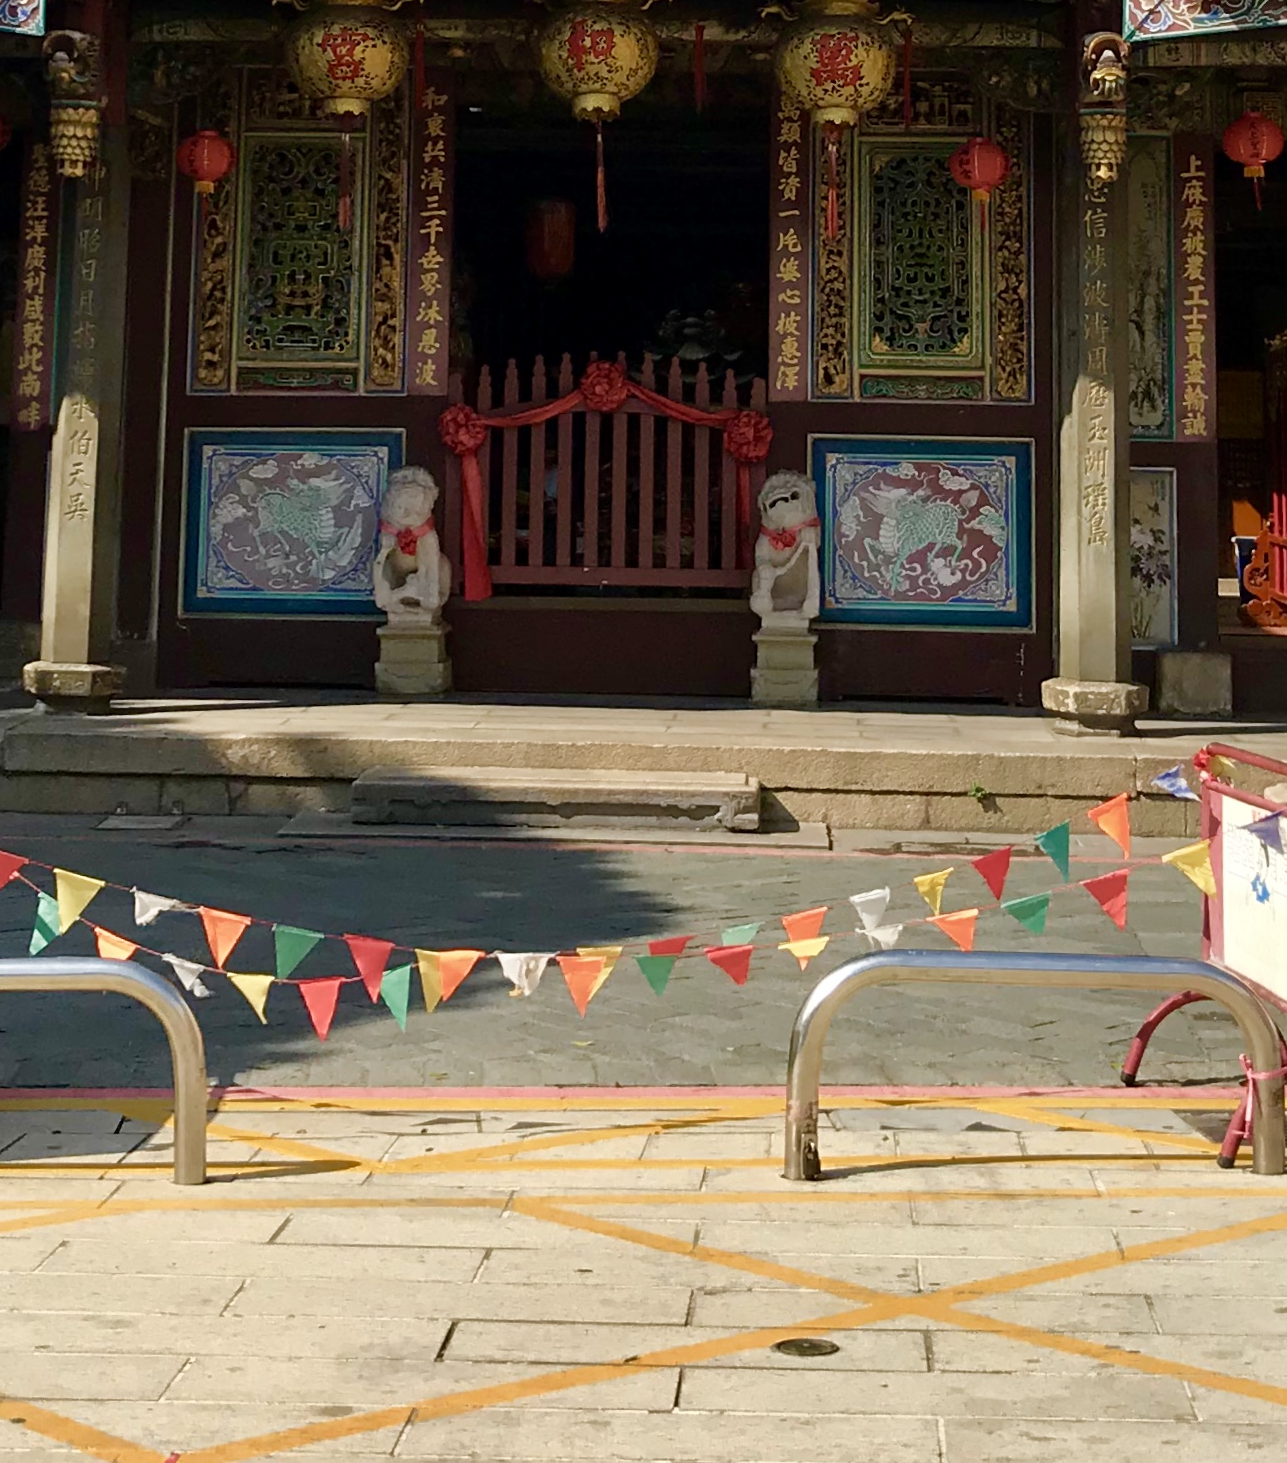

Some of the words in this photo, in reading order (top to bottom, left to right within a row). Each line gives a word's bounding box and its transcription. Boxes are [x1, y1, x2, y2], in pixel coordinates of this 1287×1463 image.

[321, 28, 370, 80] 宮
[567, 18, 614, 71] 和
[810, 33, 862, 86] 萬
